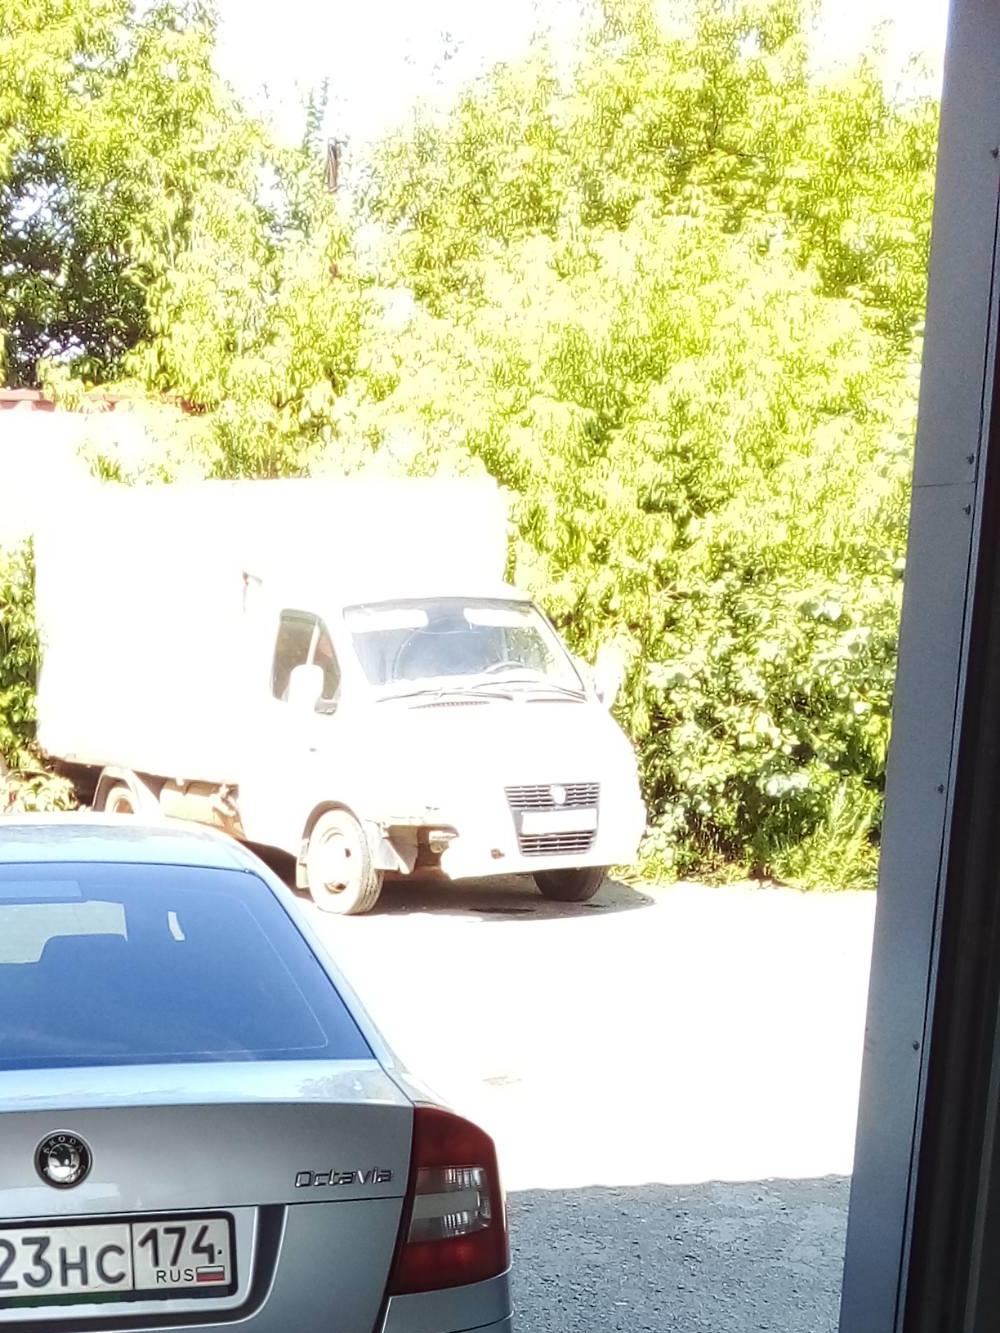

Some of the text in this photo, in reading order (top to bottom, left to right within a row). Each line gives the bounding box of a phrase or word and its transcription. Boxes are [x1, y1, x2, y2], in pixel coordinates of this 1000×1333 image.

[295, 1168, 392, 1188] Octavia
[138, 1225, 216, 1267] 174
[156, 1269, 195, 1284] RUS
